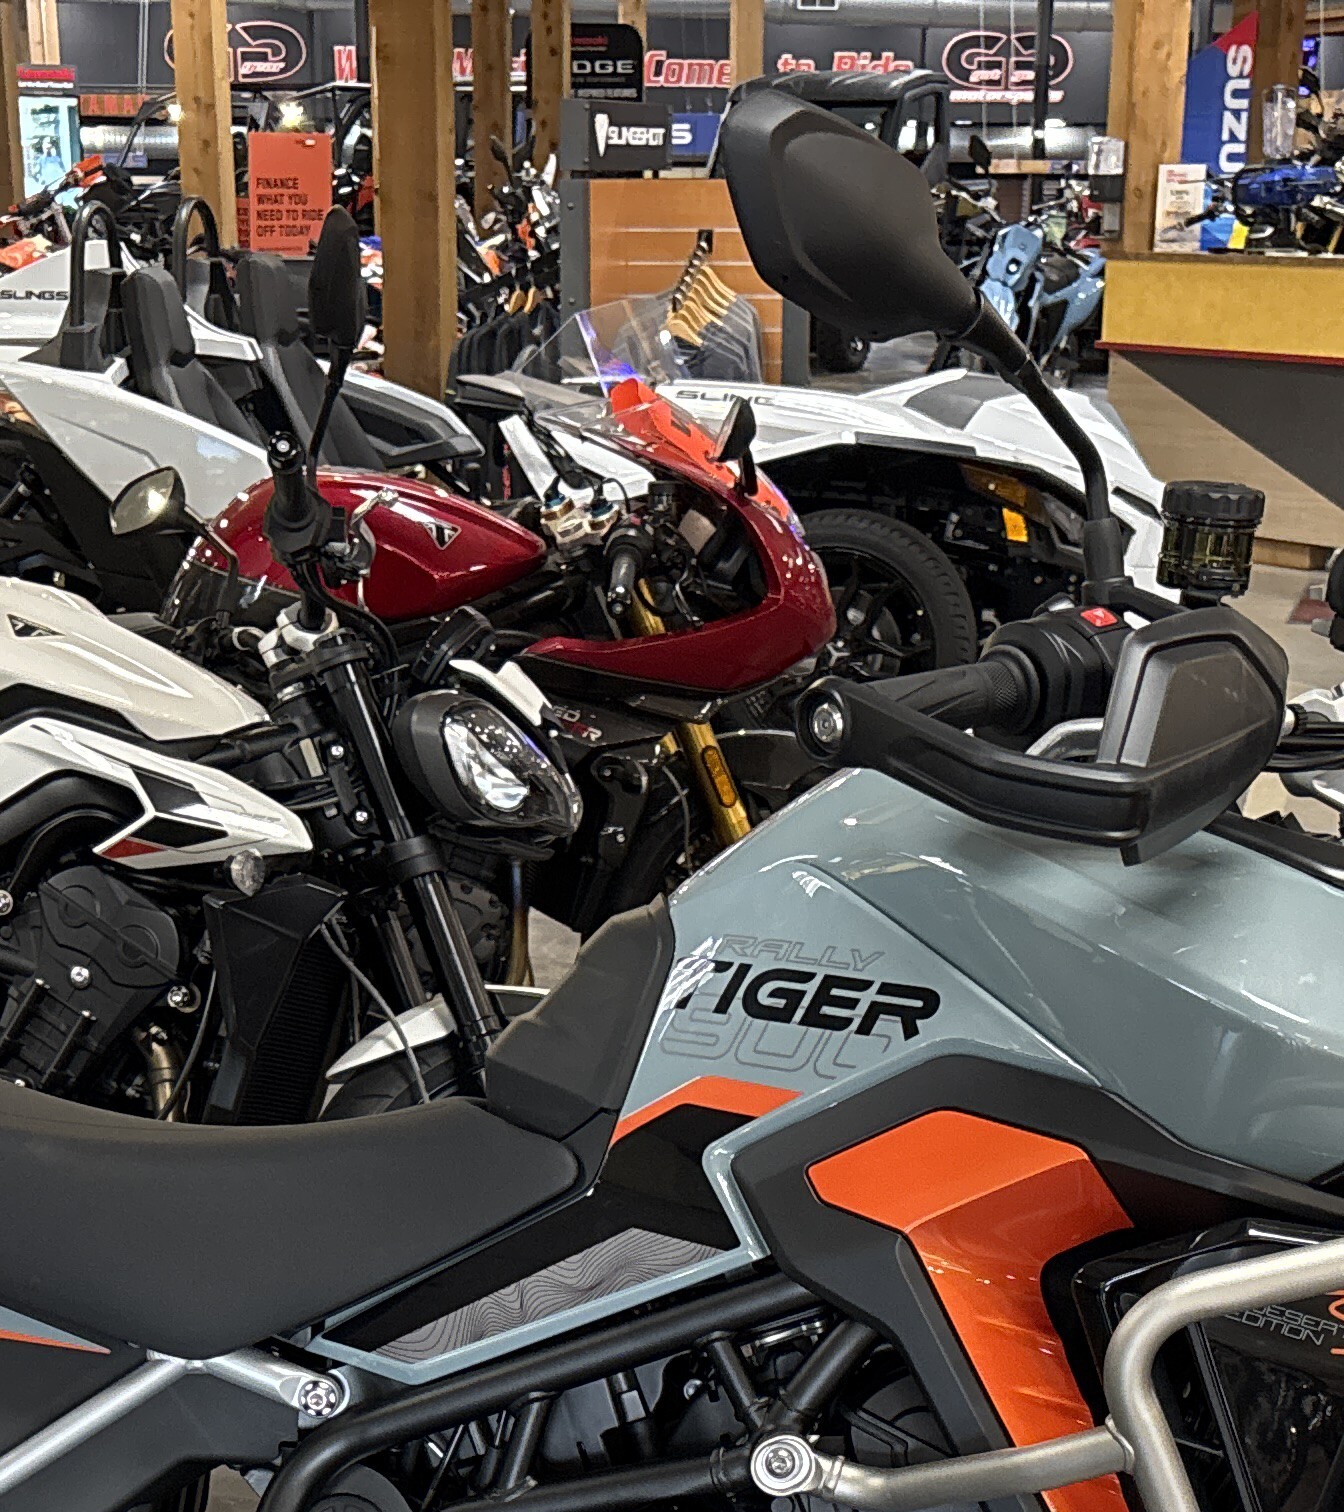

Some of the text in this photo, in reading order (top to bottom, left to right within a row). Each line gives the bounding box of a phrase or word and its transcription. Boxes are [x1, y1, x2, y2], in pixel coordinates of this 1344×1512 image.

[645, 51, 731, 88] Come
[256, 178, 299, 190] FINANCE
[256, 194, 308, 206] WHAT YOU
[256, 209, 324, 221] NEED TO RIDE
[256, 225, 311, 237] OFF TODAY
[717, 934, 886, 972] RALLY
[665, 956, 941, 1042] TIGER
